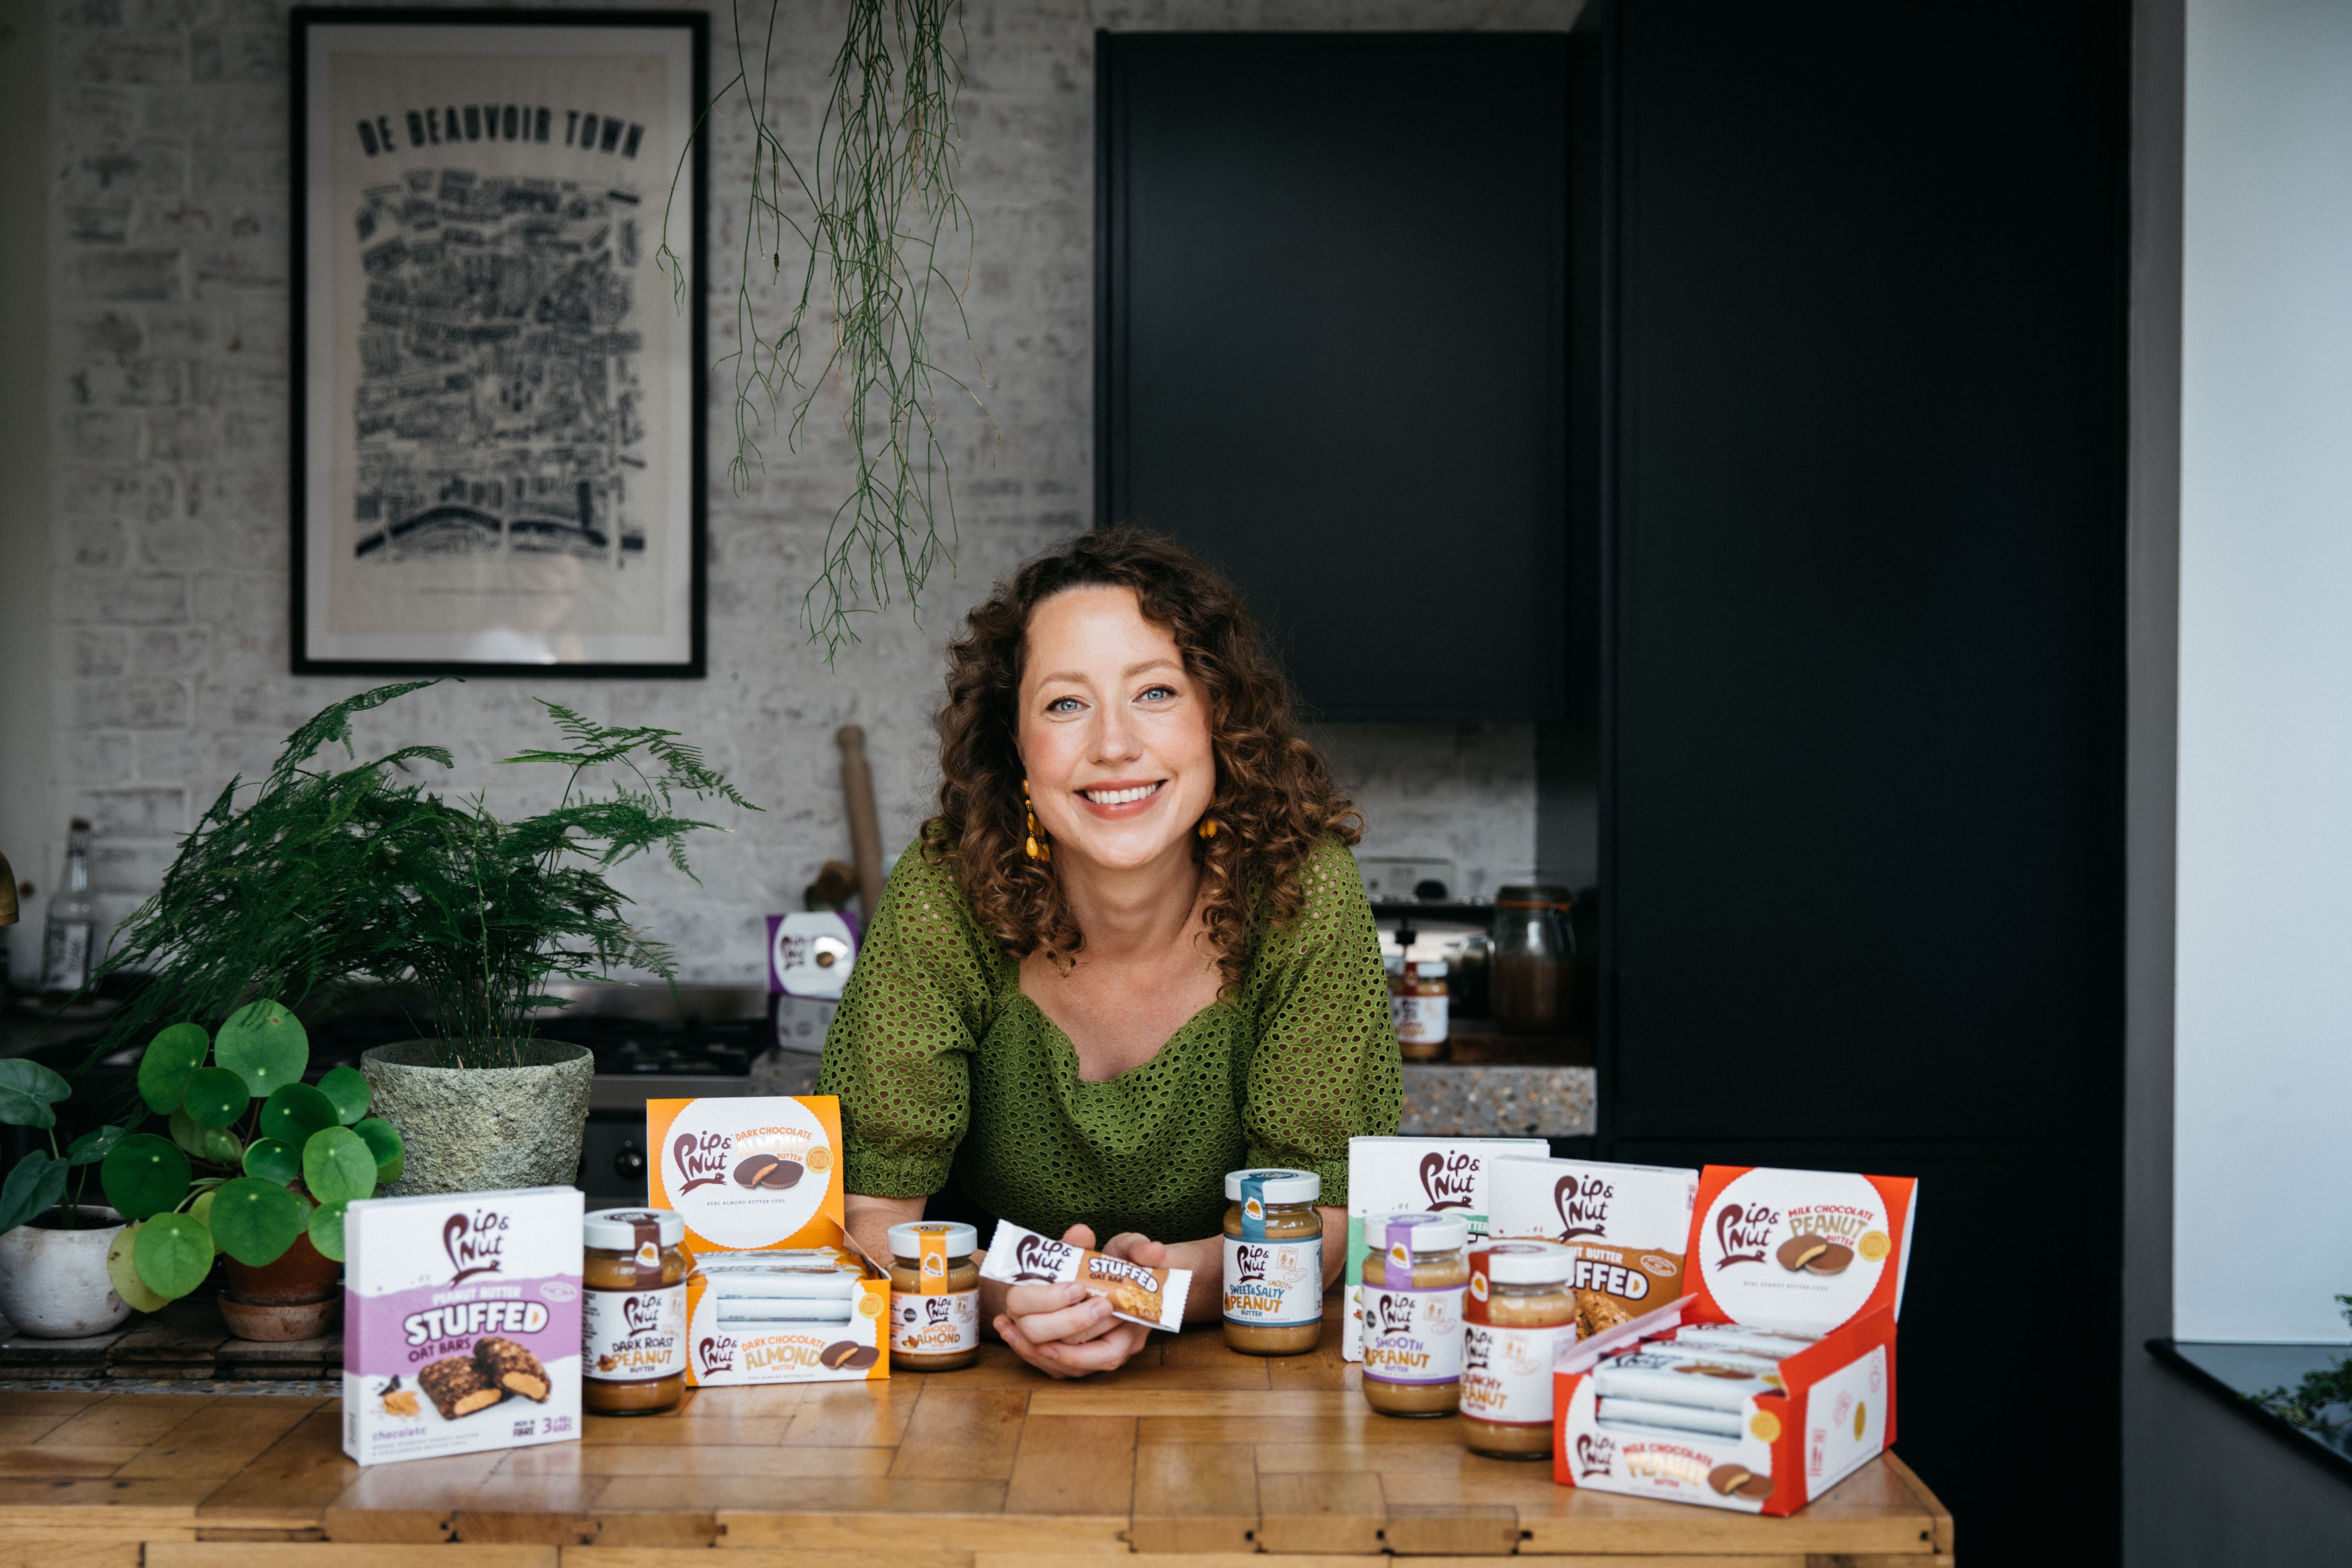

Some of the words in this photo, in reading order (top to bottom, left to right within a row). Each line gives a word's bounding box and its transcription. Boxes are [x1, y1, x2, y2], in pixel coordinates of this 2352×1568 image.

[356, 116, 395, 158] DE
[405, 103, 551, 149] BEAUVOIR
[566, 109, 645, 160] TOWN
[735, 1129, 758, 1141] DARK
[759, 1127, 812, 1140] CHOCOLATE
[674, 1130, 721, 1180] Pip
[737, 1135, 809, 1159] ALMOND
[689, 1152, 727, 1178] Nut
[777, 1153, 802, 1162] BUTTER
[1420, 1150, 1470, 1202] Pip
[1435, 1175, 1475, 1199] Nut
[1555, 1175, 1604, 1227] Pip
[1569, 1200, 1609, 1224] Nut
[1788, 1206, 1811, 1218] MILK
[1814, 1205, 1874, 1221] CHOCOLATE
[1467, 1220, 1489, 1232] TTER
[1716, 1202, 1770, 1254] Pip
[1789, 1215, 1868, 1239] PEANUT
[443, 1209, 498, 1268] Pip
[1730, 1226, 1772, 1252] Nut
[1826, 1235, 1854, 1246] BUTTER
[460, 1235, 503, 1265] Nut
[1017, 1234, 1063, 1271] Pip
[1237, 1245, 1263, 1274] Pip
[1586, 1247, 1623, 1264] BUTTER
[1027, 1252, 1065, 1272] Nut
[1244, 1259, 1266, 1272] Nut
[1089, 1257, 1159, 1294] STUFFED
[1108, 1275, 1124, 1284] BAR
[1268, 1280, 1293, 1291] SMOOTH
[1566, 1258, 1649, 1300] FFED
[624, 1294, 655, 1328] Pip
[926, 1297, 947, 1319] Pip
[932, 1307, 949, 1318] Nut
[1230, 1295, 1283, 1313] PEANUT
[1380, 1294, 1408, 1326] Pip
[403, 1300, 549, 1346] STUFFED
[634, 1309, 660, 1325] Nut
[1388, 1310, 1412, 1324] Nut
[917, 1333, 961, 1345] ALMOND
[922, 1324, 957, 1334] SMOOTH
[408, 1345, 434, 1362] OAT
[439, 1338, 470, 1355] BARS
[612, 1338, 642, 1353] DARK
[645, 1337, 674, 1348] ROAST
[699, 1336, 731, 1368] Pip
[741, 1338, 766, 1352] DARK
[768, 1335, 826, 1350] CHOCOLATE
[1375, 1337, 1423, 1351] SMOOTH
[612, 1350, 673, 1367] PEANUT
[709, 1350, 734, 1364] Nut
[745, 1345, 821, 1371] ALMOND
[1372, 1349, 1430, 1369] PEANUT
[373, 1427, 427, 1441] chocolate
[513, 1427, 535, 1438] FIBRE
[542, 1417, 552, 1434] 3
[1587, 1451, 1611, 1465] Nut
[1622, 1442, 1645, 1455] MILK
[1649, 1443, 1713, 1467] CHOCOLATE
